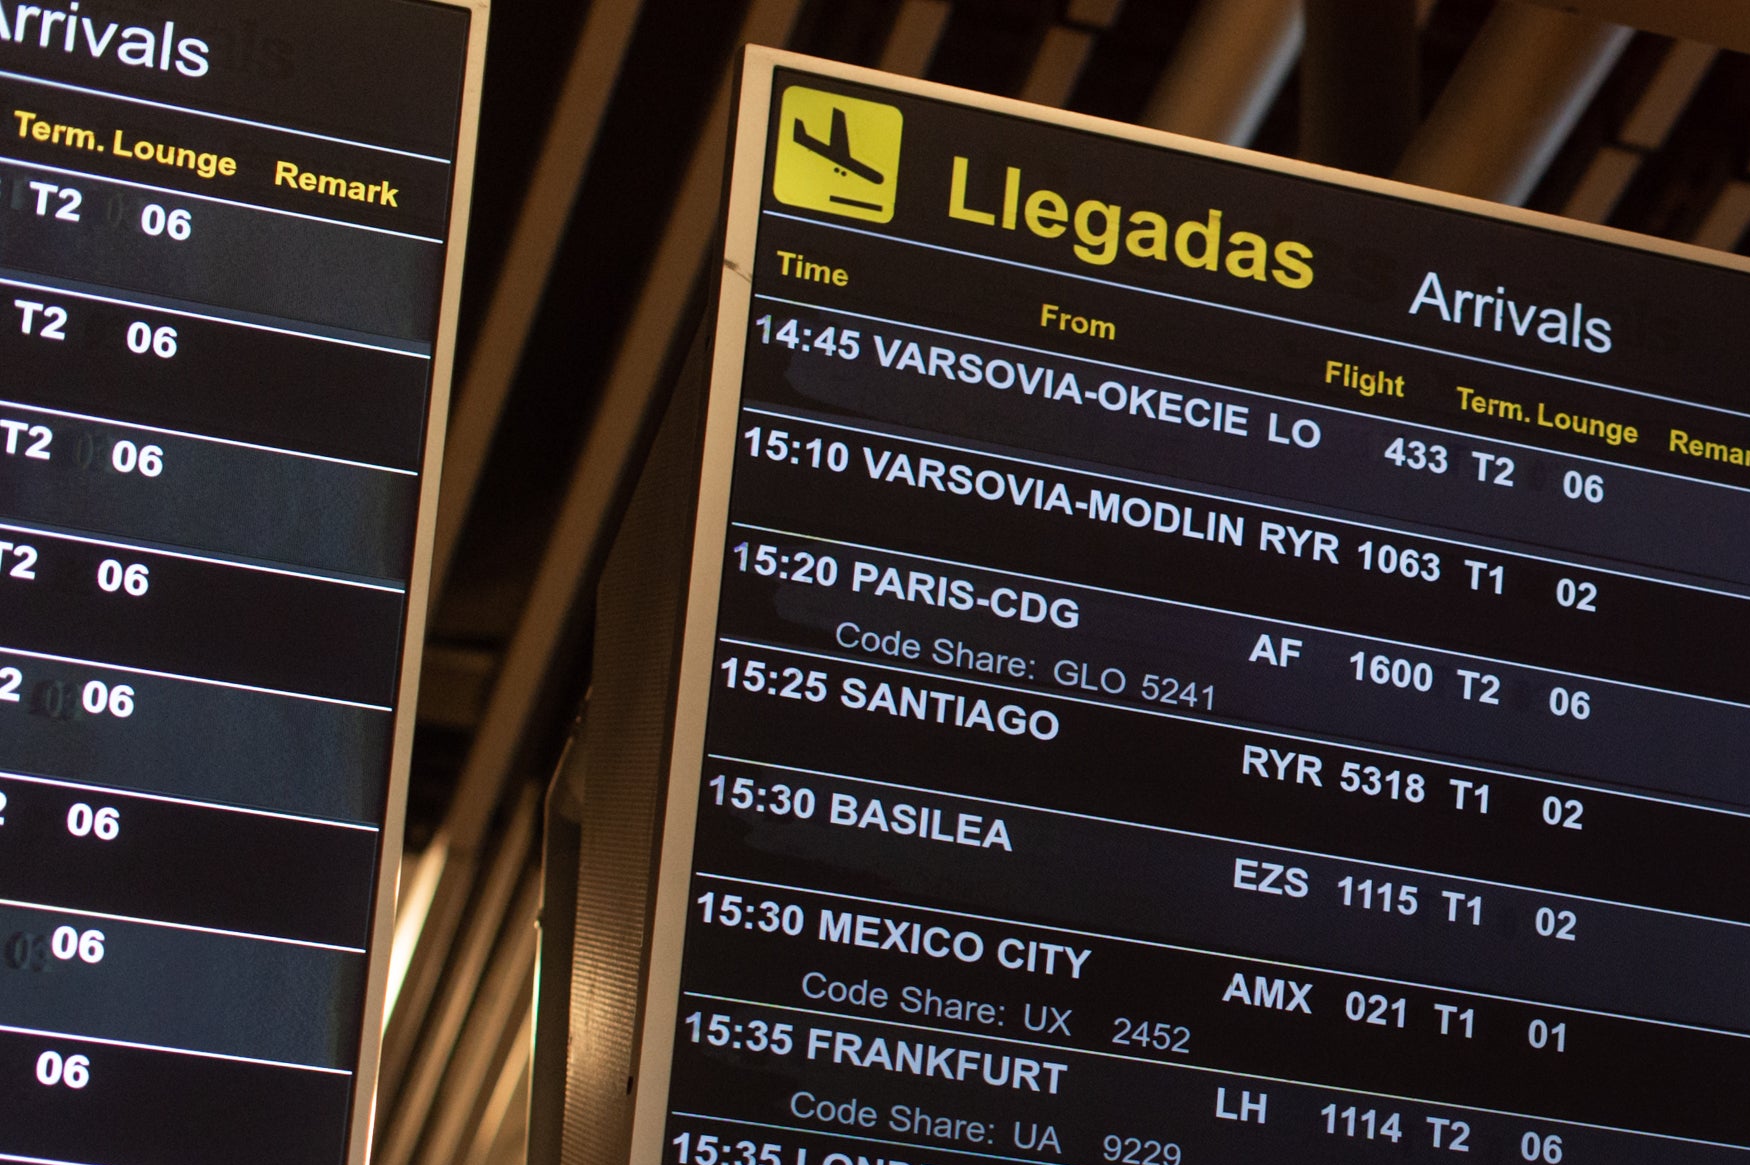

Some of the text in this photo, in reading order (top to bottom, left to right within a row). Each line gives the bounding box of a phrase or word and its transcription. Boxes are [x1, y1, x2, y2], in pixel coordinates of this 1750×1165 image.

[0, 1, 210, 78] rrivals
[14, 110, 399, 208] Term. Lounge Remark
[948, 157, 1612, 354] Llegadas Arrivals
[14, 299, 178, 359] T2 06
[776, 250, 849, 287] Time
[1040, 303, 1116, 341] From
[1325, 360, 1405, 398] Flight
[1456, 386, 1531, 423] Term.
[1537, 402, 1639, 446] Lounge
[756, 314, 1604, 504] 14:45 VARSOVIA-OKECIE LO 433 T2 06
[733, 542, 1591, 720] 15:20 PARIS-CDG AF 1600 T2 06
[835, 621, 1214, 711] Code Share: GLO 5241
[66, 802, 120, 841] 06
[697, 891, 1566, 1053] 15:30 MEXICO CITY AMX 021 T1 01
